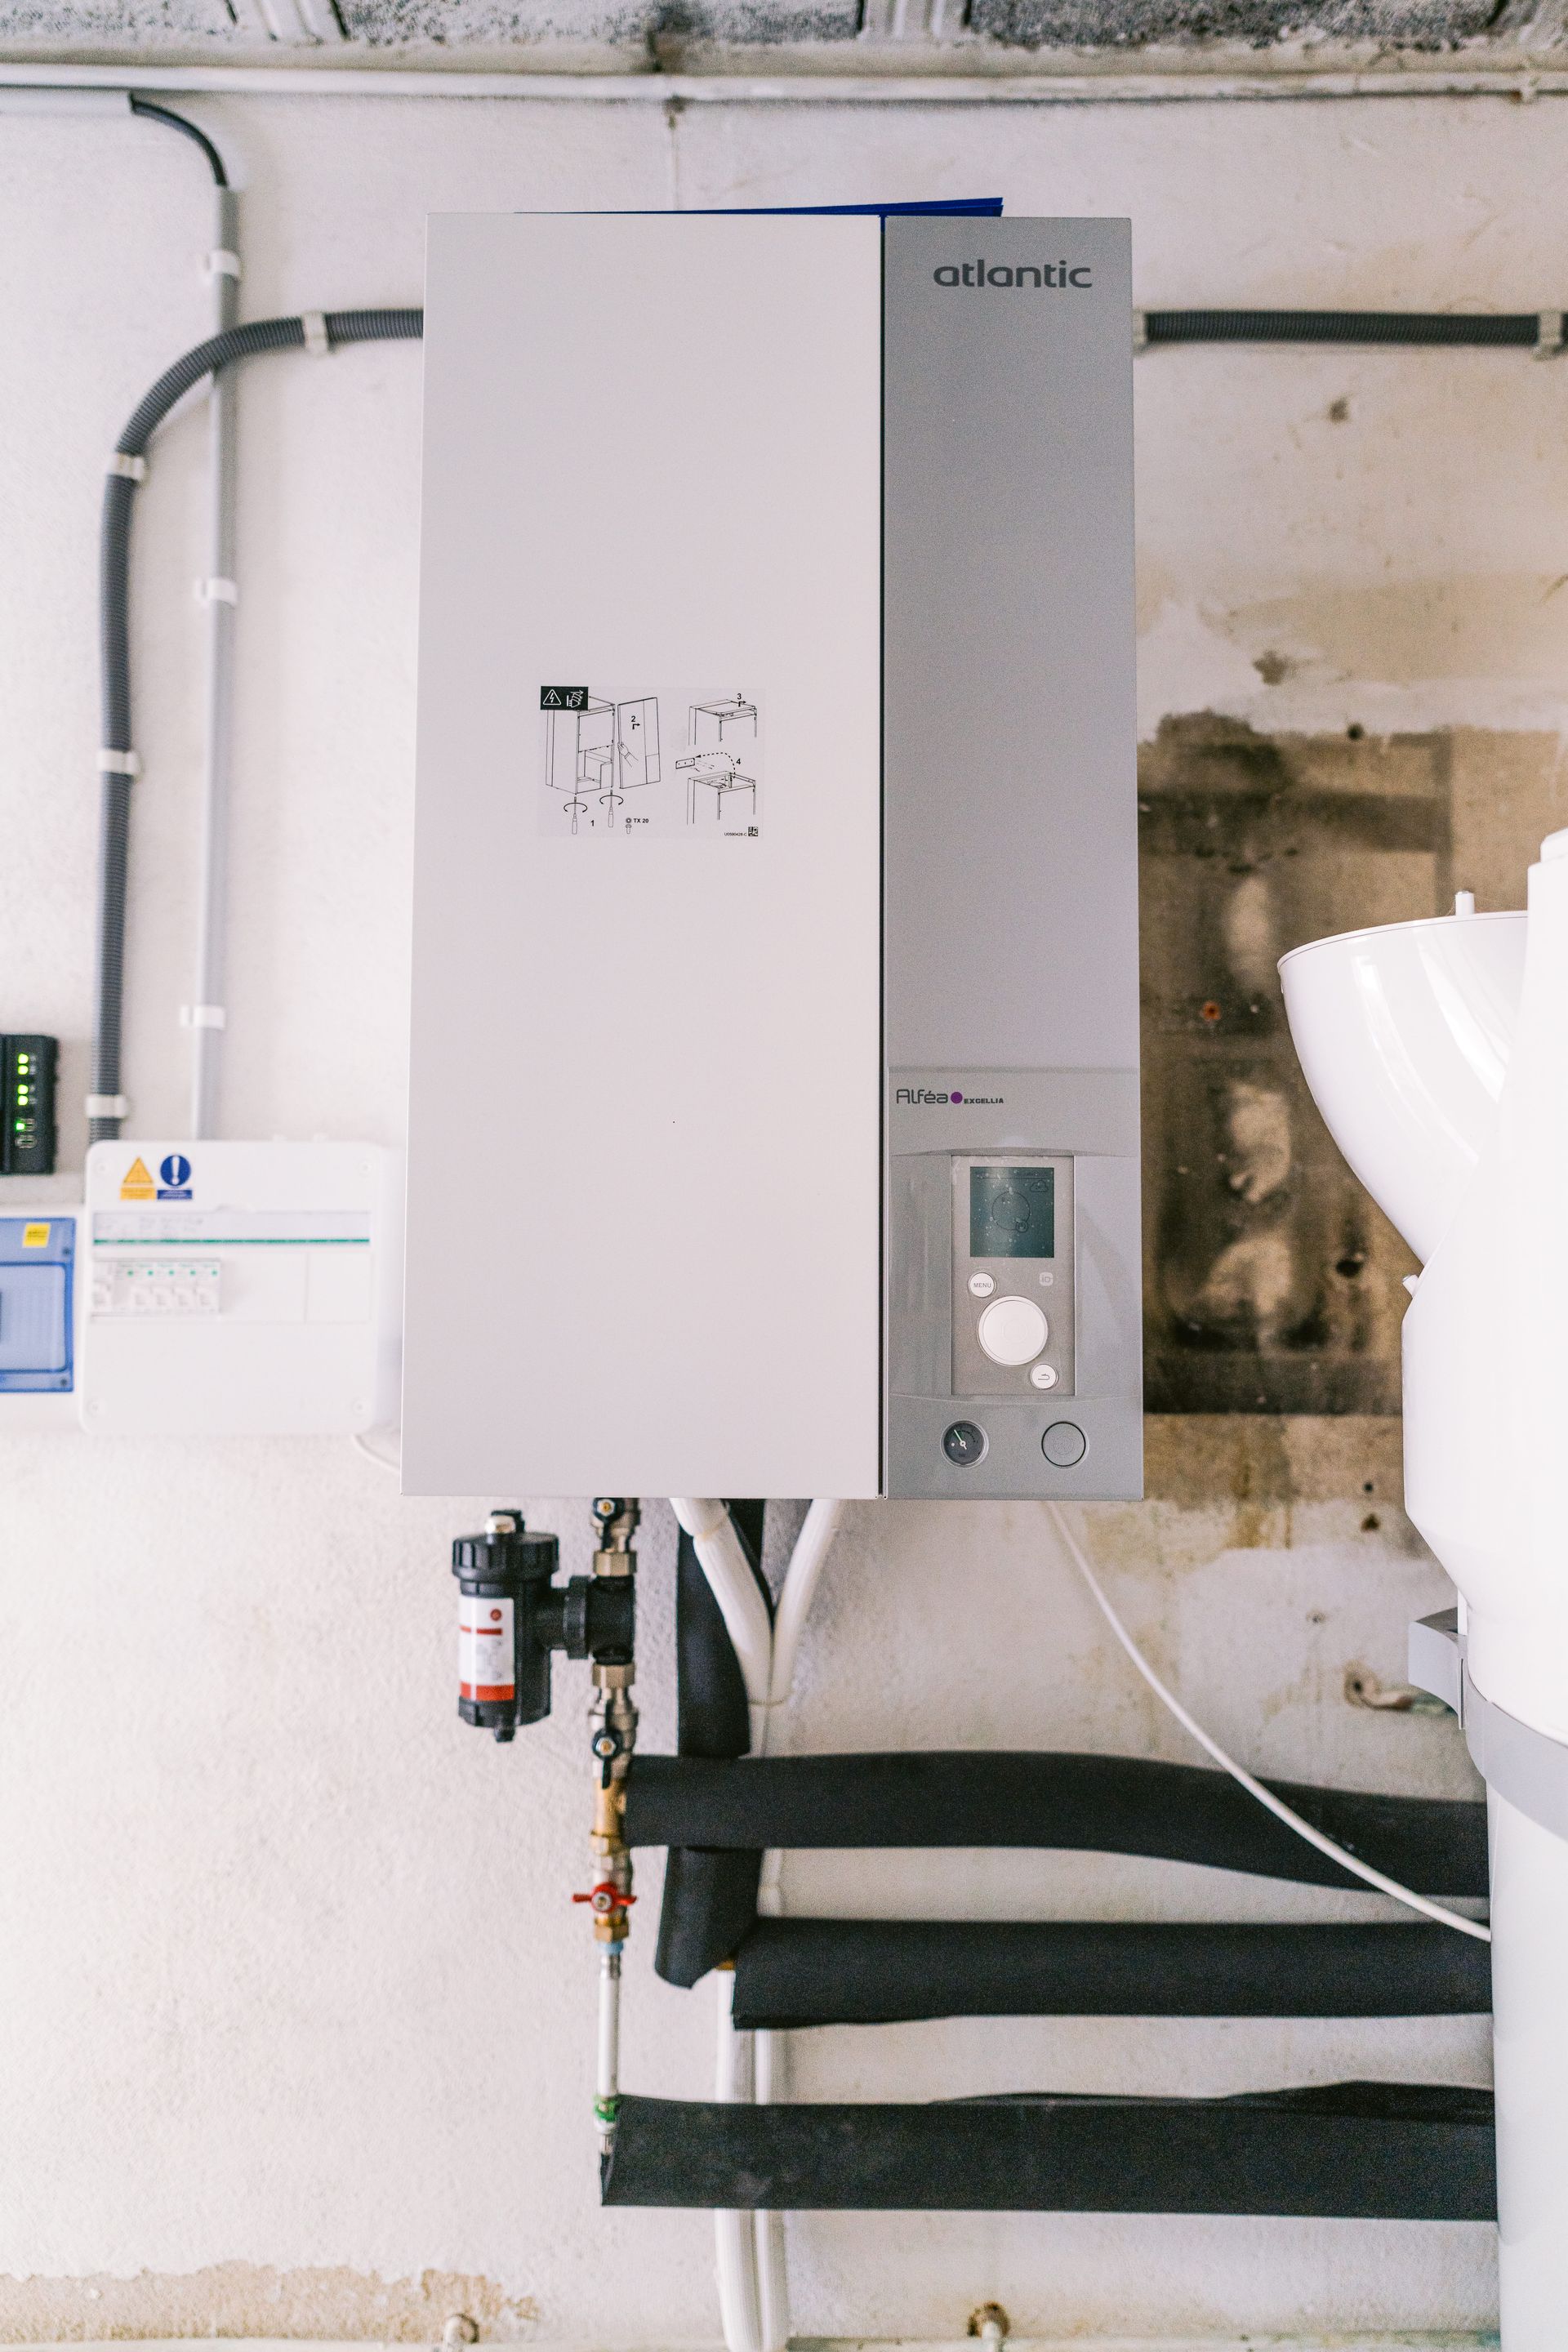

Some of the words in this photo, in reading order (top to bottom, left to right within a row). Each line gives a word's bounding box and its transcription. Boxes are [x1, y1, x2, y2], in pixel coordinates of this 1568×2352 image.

[933, 259, 1093, 288] atlantic
[630, 715, 636, 723] 2
[896, 1089, 949, 1104] Alféa
